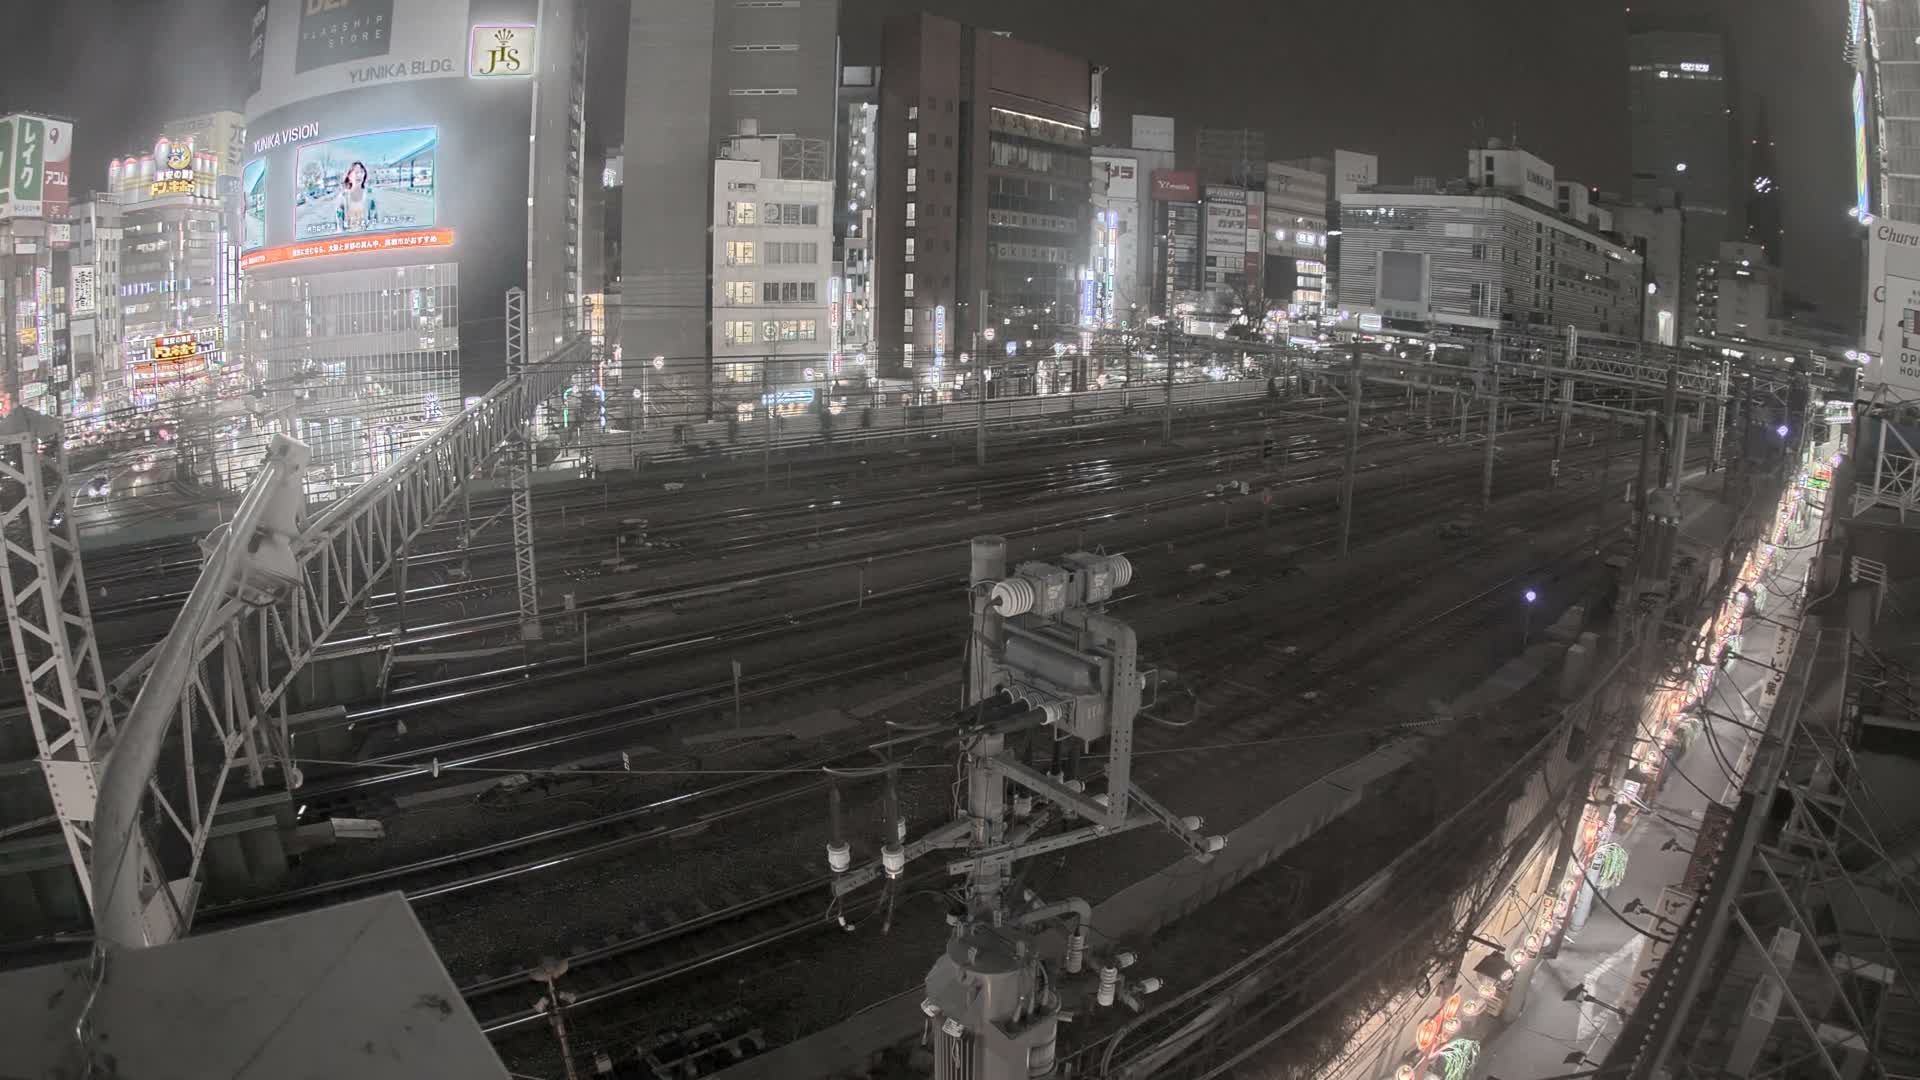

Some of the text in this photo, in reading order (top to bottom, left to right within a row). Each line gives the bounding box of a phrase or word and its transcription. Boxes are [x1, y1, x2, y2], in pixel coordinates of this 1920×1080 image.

[303, 15, 383, 40] FLAGSHIP
[327, 29, 383, 49] STORE
[350, 63, 408, 83] YUNIKA
[254, 132, 281, 154] YUNIKA
[282, 121, 319, 145] VISION
[21, 122, 36, 189] レイク
[45, 170, 68, 186] アコム
